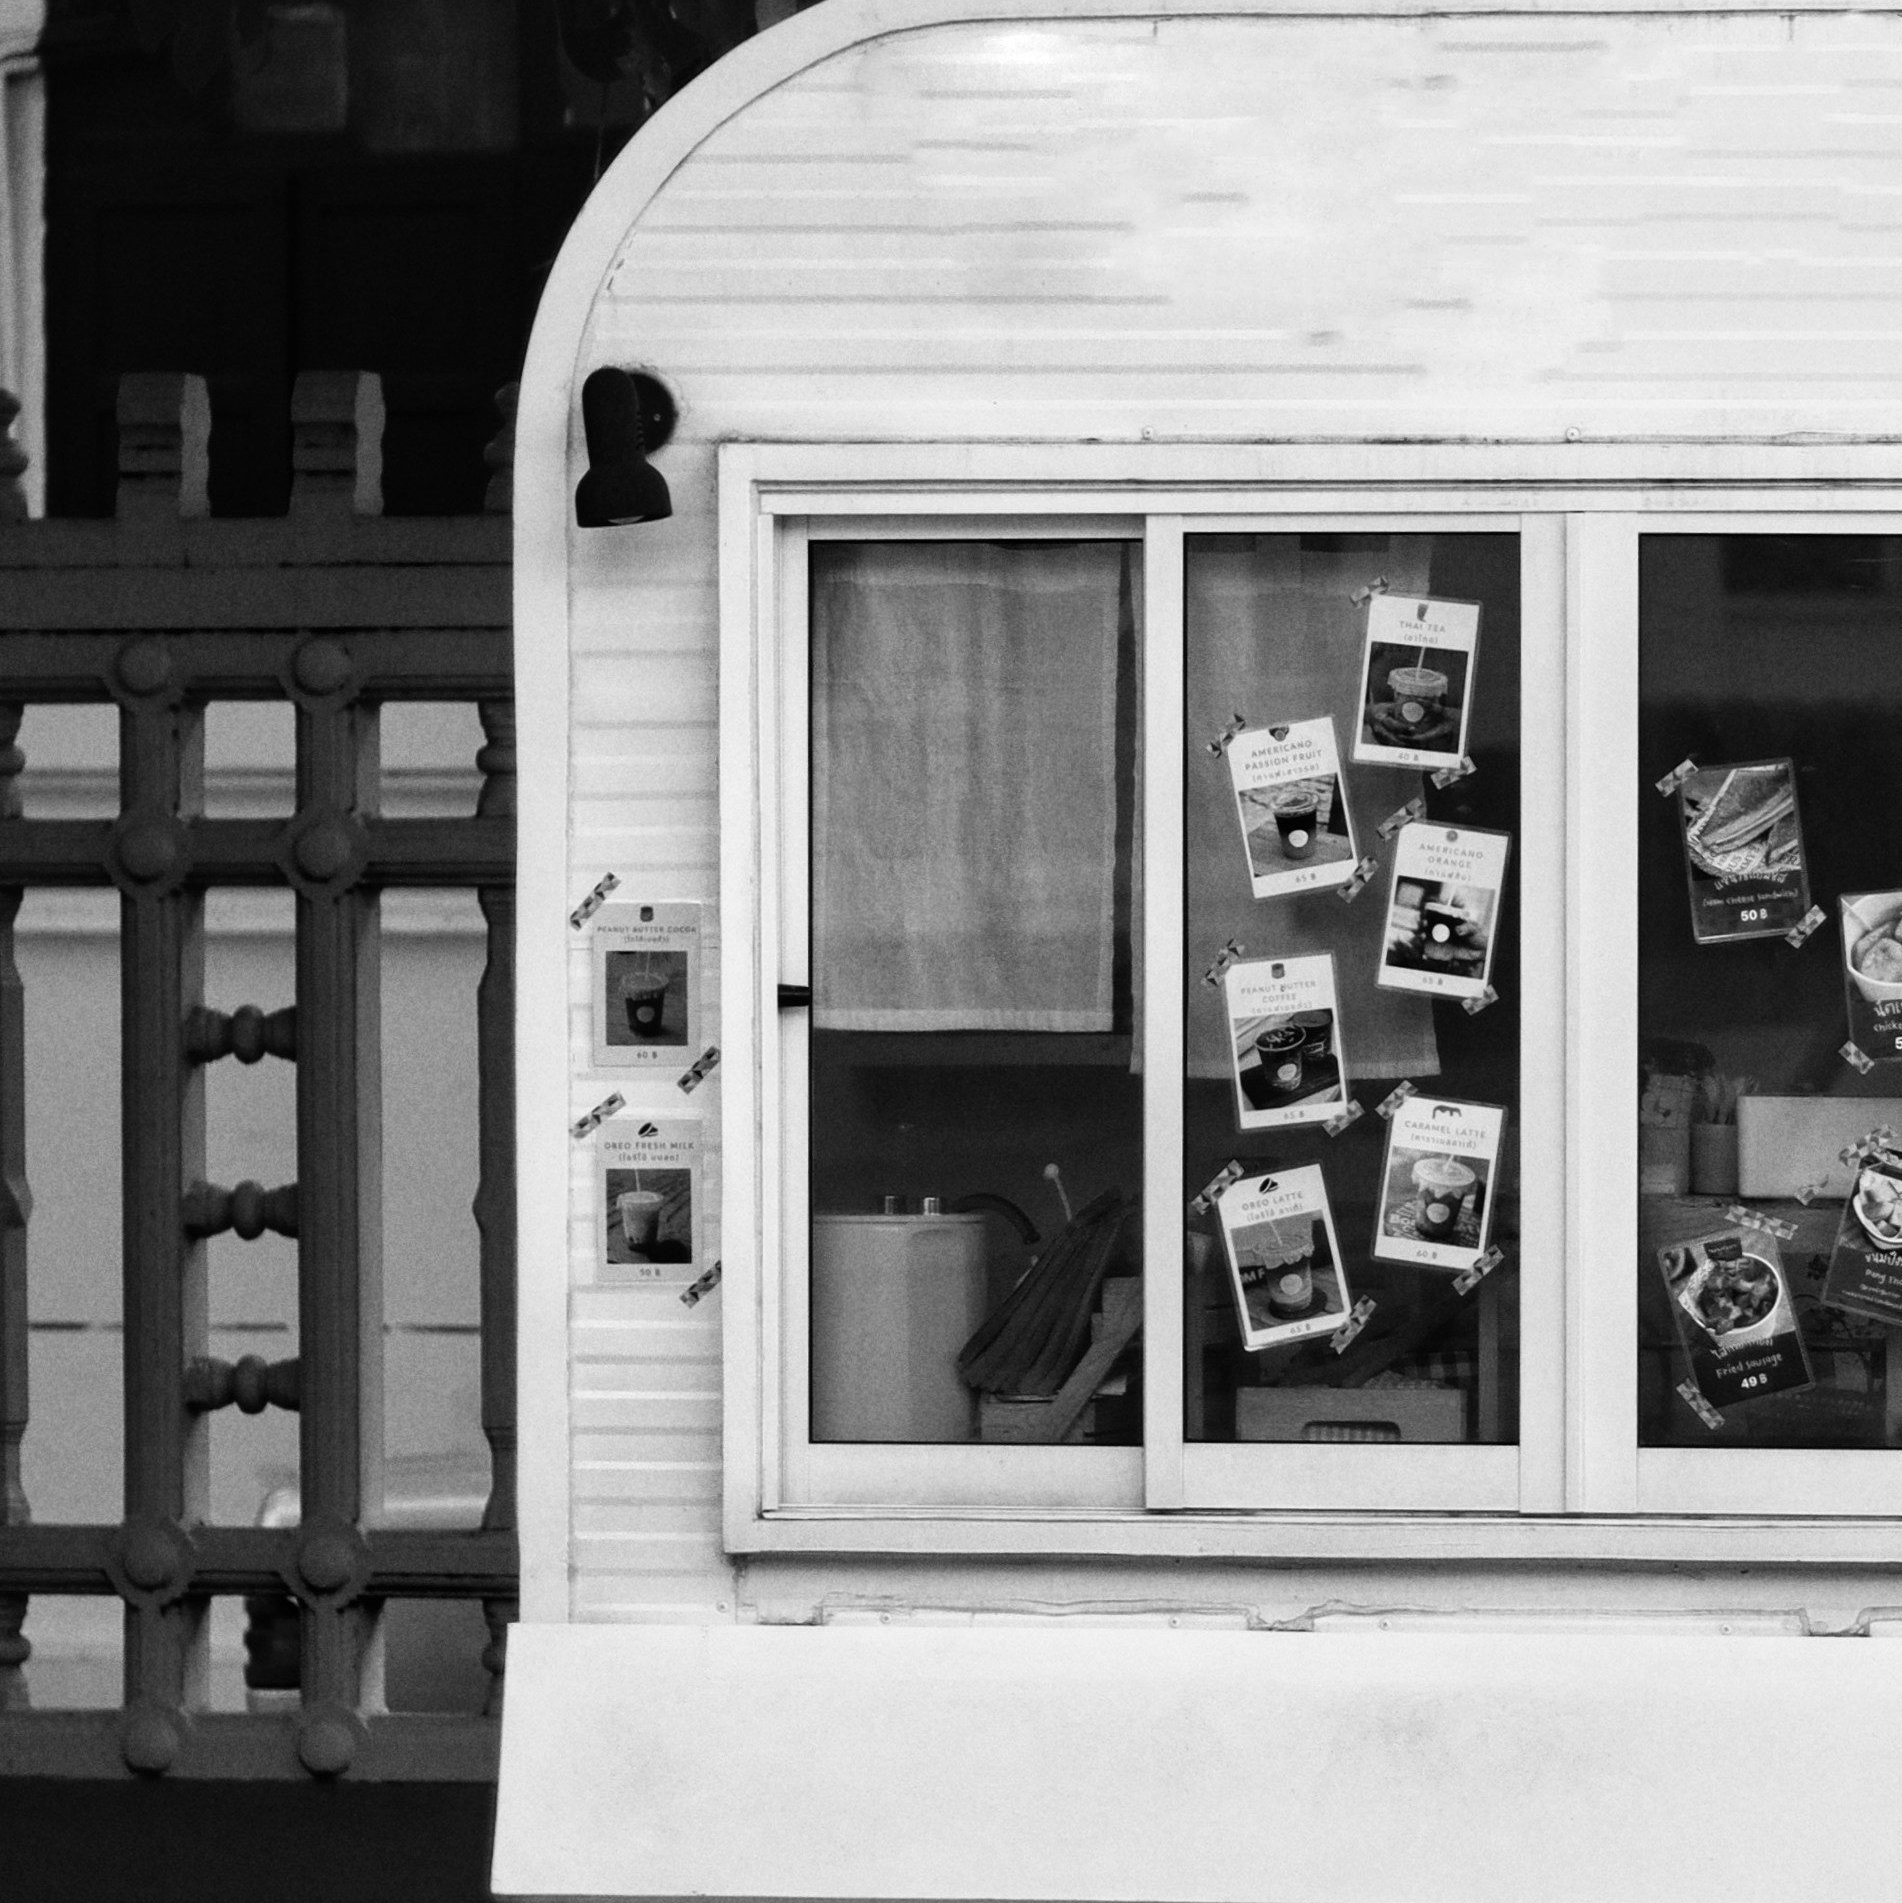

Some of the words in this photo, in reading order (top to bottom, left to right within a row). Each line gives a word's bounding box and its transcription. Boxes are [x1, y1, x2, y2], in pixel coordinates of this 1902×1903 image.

[1399, 620, 1424, 631] THAI
[1427, 623, 1446, 633] TEA
[1251, 740, 1312, 758] AMERICANO
[1244, 757, 1289, 771] PASSION
[1292, 749, 1322, 761] FRUIT
[1419, 842, 1483, 859] AMERICANO
[1427, 855, 1472, 869] ORANGE
[1740, 909, 1758, 922] 50
[597, 926, 629, 934] PEANUT
[667, 925, 697, 934] COCOA
[1240, 984, 1276, 995] PEANUT
[1262, 993, 1297, 1003] COFFEE
[1404, 1120, 1451, 1134] CARAMEL
[1455, 1127, 1486, 1139] LATTE
[604, 1142, 631, 1150] OREO
[635, 1142, 666, 1150] FRESH
[670, 1141, 695, 1150] MILK
[1241, 1198, 1270, 1211] OREO
[1273, 1191, 1303, 1205] LATTE
[1716, 1361, 1744, 1379] Fried
[1740, 1375, 1758, 1389] 49
